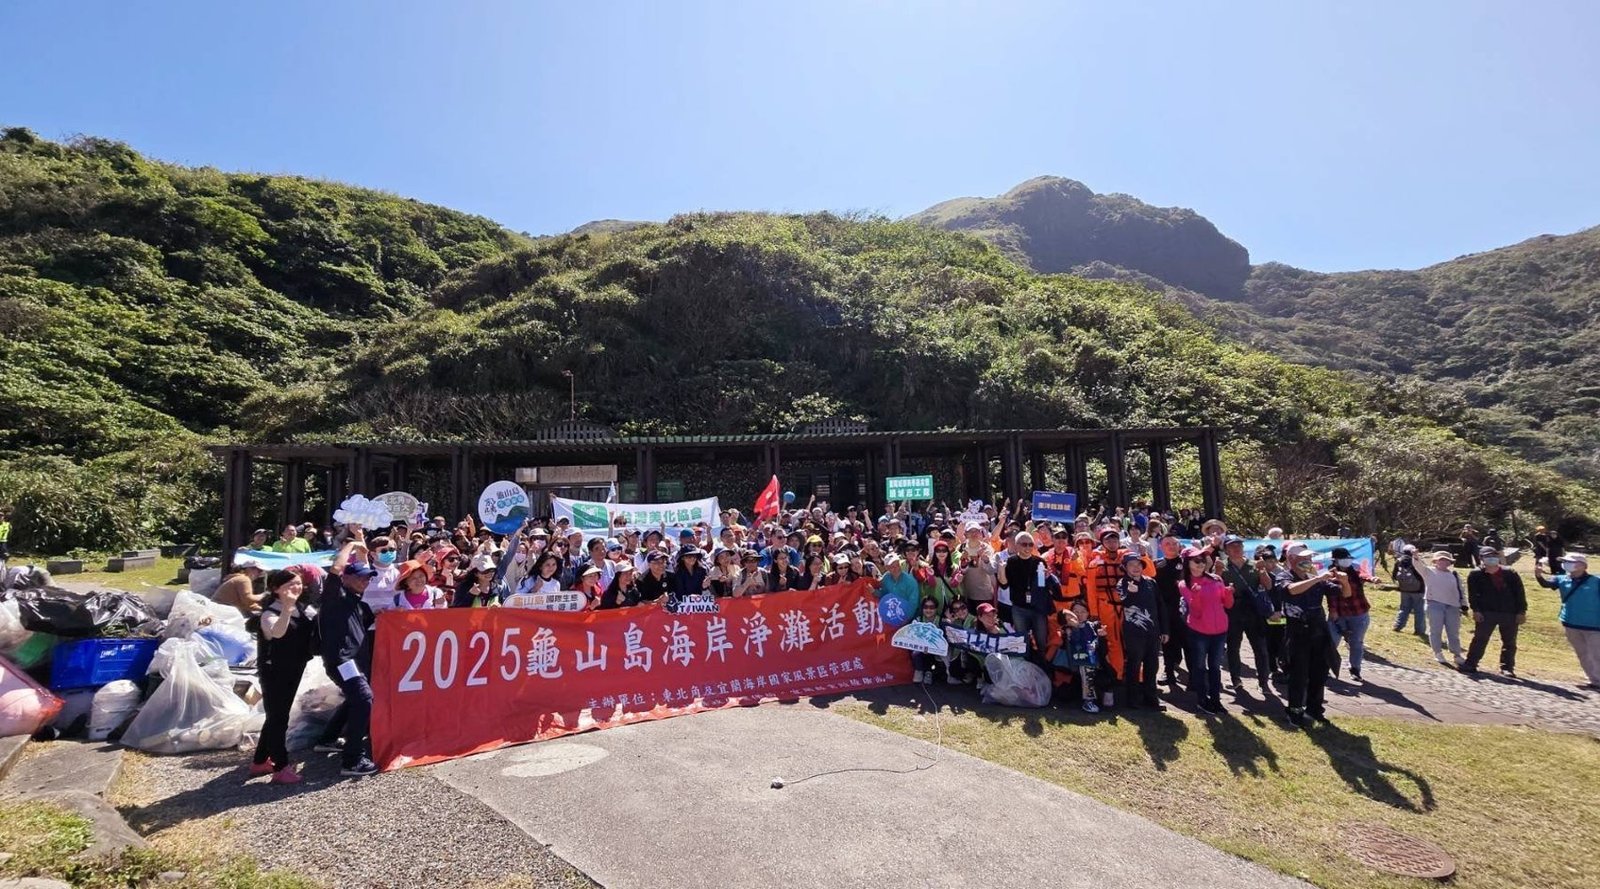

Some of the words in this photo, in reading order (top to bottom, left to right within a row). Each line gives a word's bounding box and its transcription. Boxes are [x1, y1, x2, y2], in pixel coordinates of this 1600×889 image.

[621, 506, 702, 524] 台灣美化協會
[398, 596, 884, 692] 2025龜山島海岸淨灘活動
